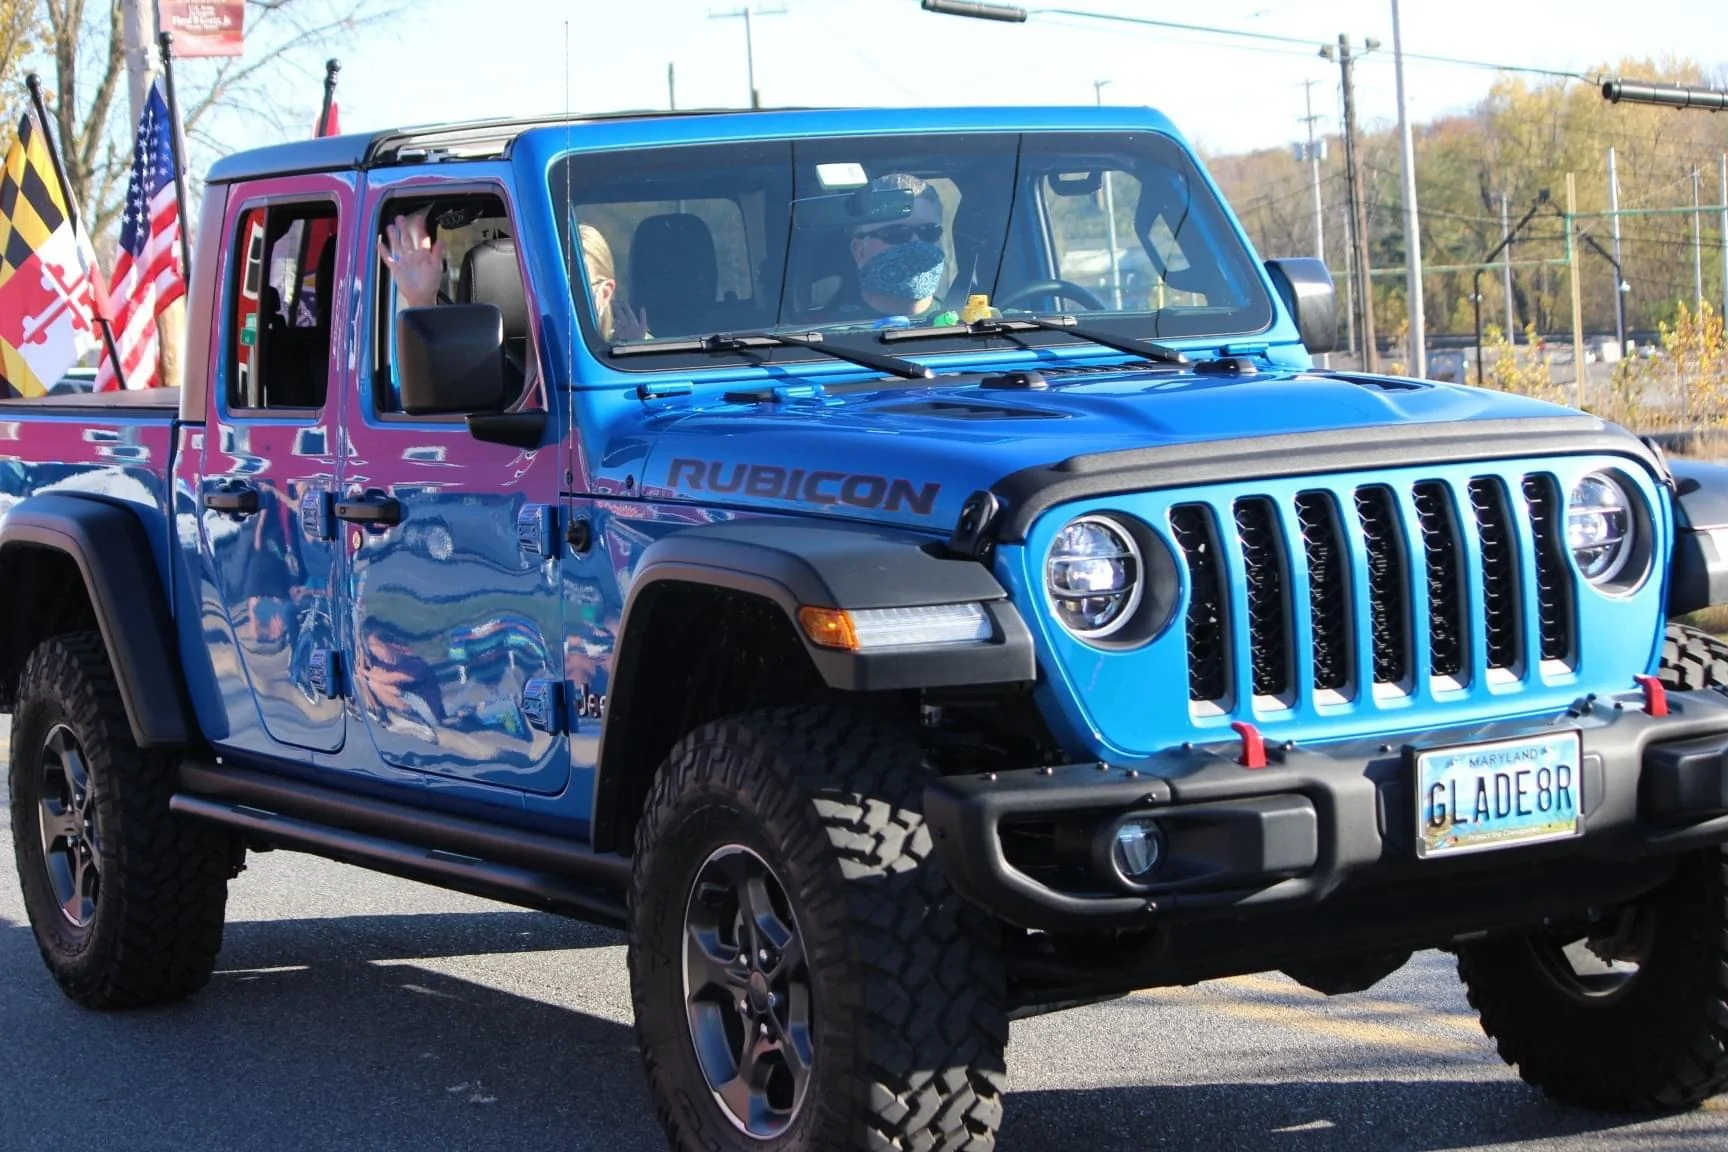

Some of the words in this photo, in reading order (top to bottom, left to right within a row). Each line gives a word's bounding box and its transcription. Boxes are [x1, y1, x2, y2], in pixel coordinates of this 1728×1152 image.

[667, 457, 940, 515] RUBICON
[1469, 748, 1538, 767] MARYLAND
[1429, 765, 1572, 828] GLADE8R
